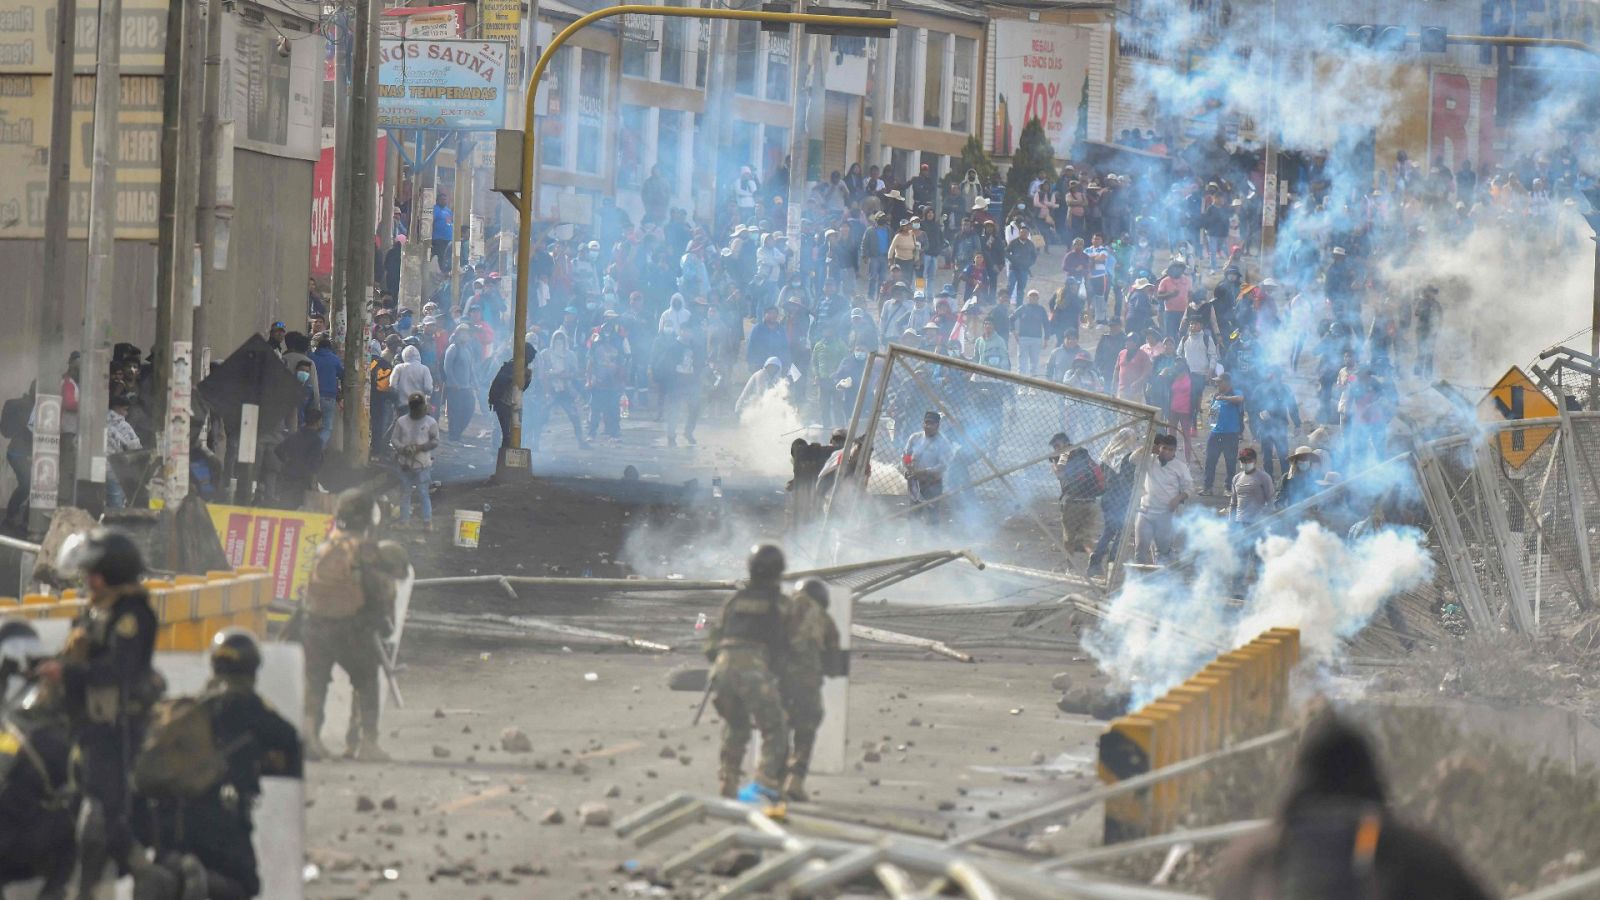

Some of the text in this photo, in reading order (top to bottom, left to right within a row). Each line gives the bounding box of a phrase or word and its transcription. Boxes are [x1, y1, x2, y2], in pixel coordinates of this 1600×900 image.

[427, 44, 496, 82] SAUNA
[408, 85, 498, 100] TEMPERADAS
[440, 108, 486, 117] EXTRAS
